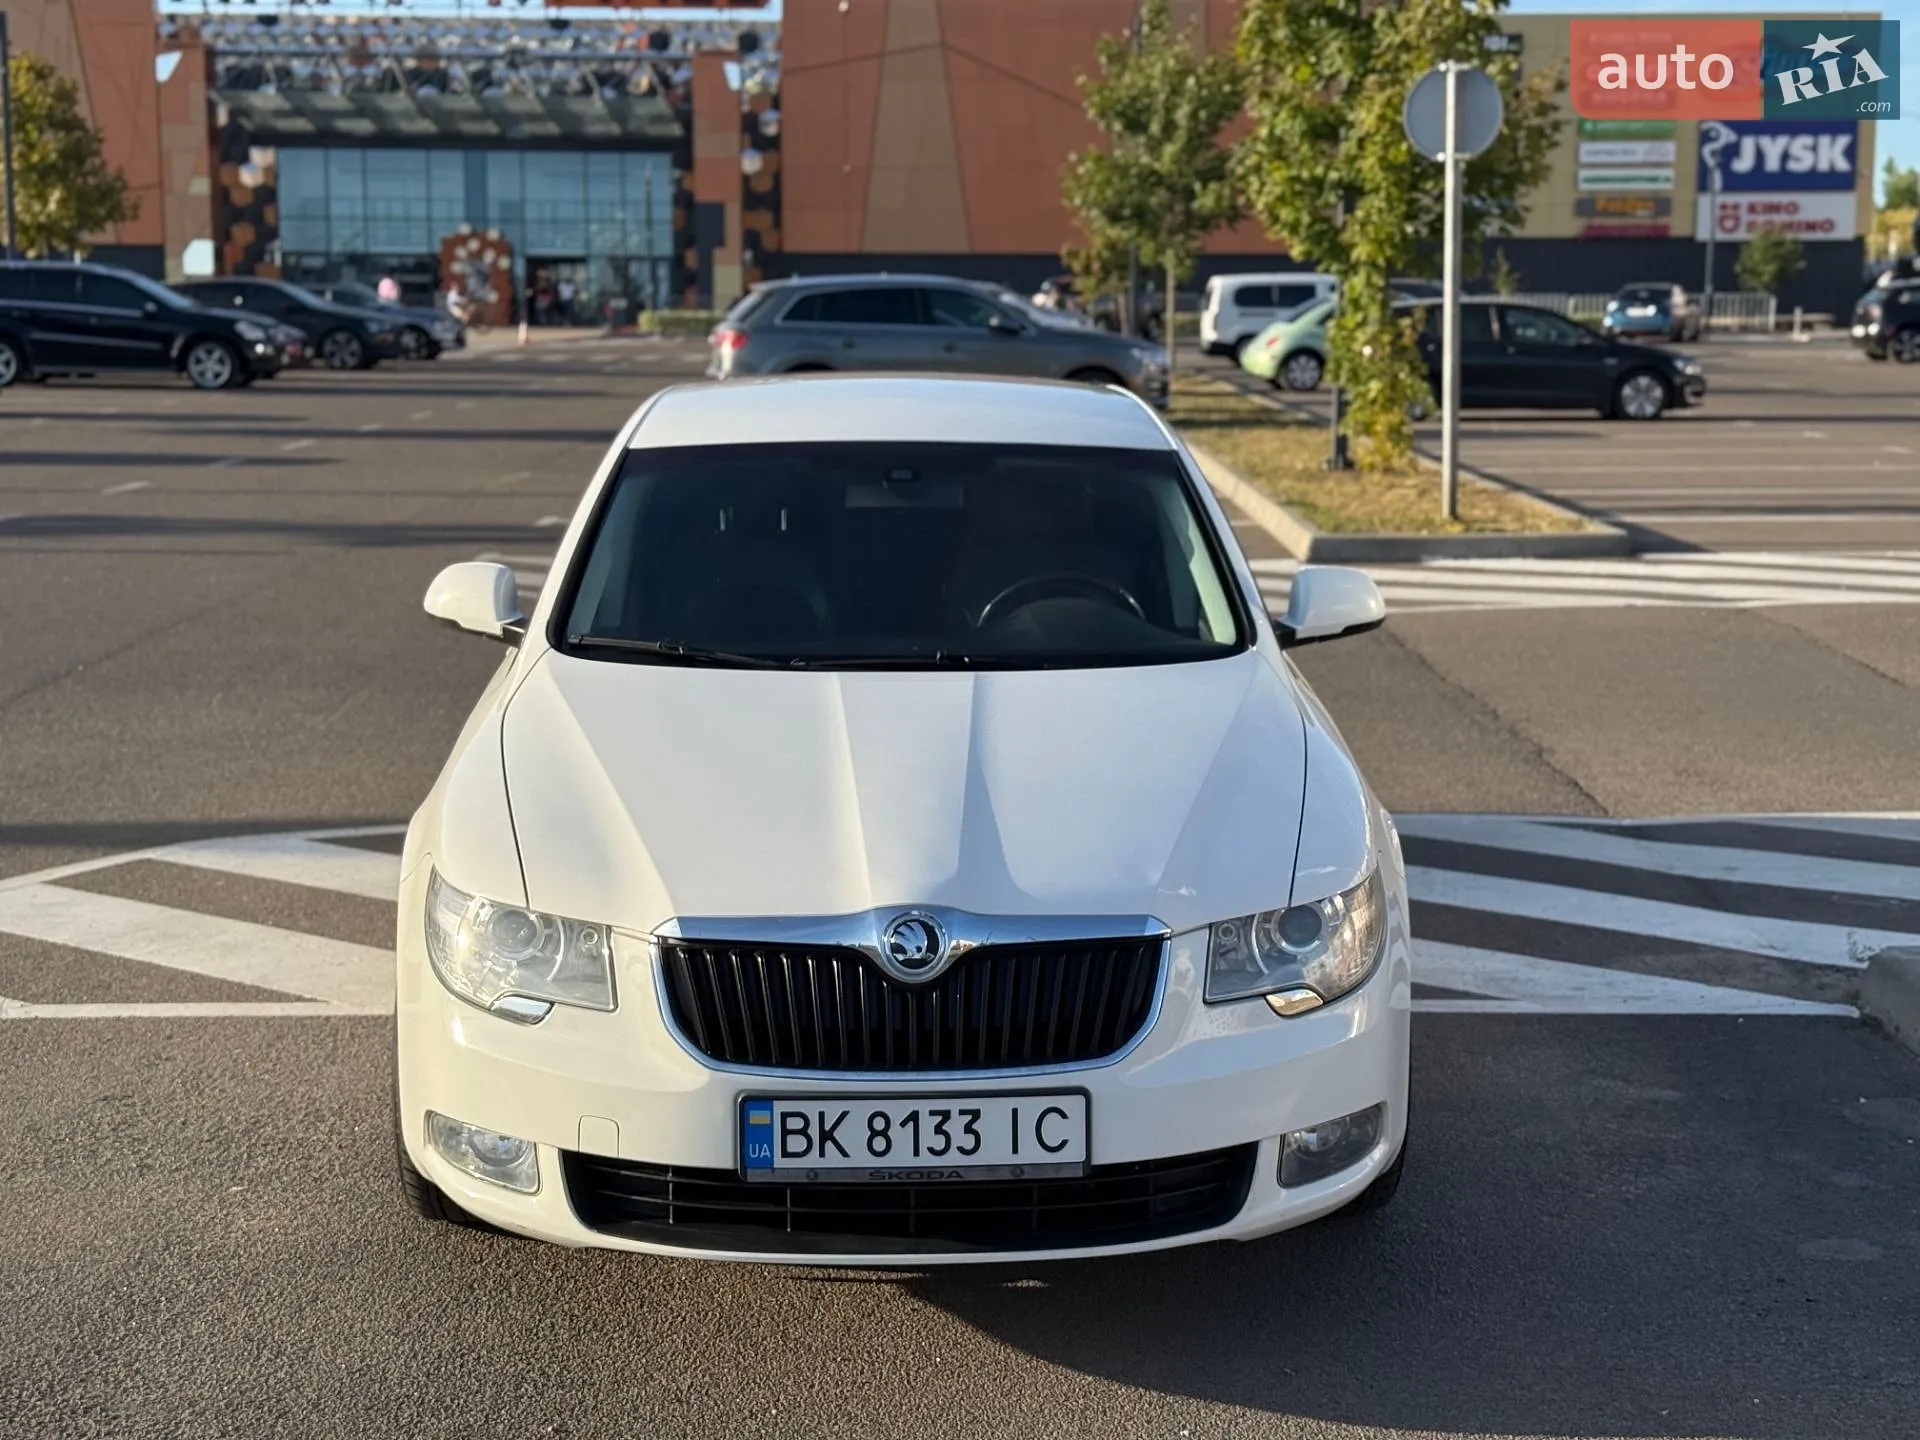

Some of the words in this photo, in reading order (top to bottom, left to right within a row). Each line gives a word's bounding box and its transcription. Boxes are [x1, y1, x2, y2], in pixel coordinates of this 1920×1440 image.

[1730, 134, 1853, 174] JYSK
[1747, 201, 1799, 214] KINO
[779, 1110, 851, 1159] BK
[866, 1108, 982, 1158] 8133
[1011, 1106, 1070, 1155] IC
[749, 1143, 771, 1159] UA
